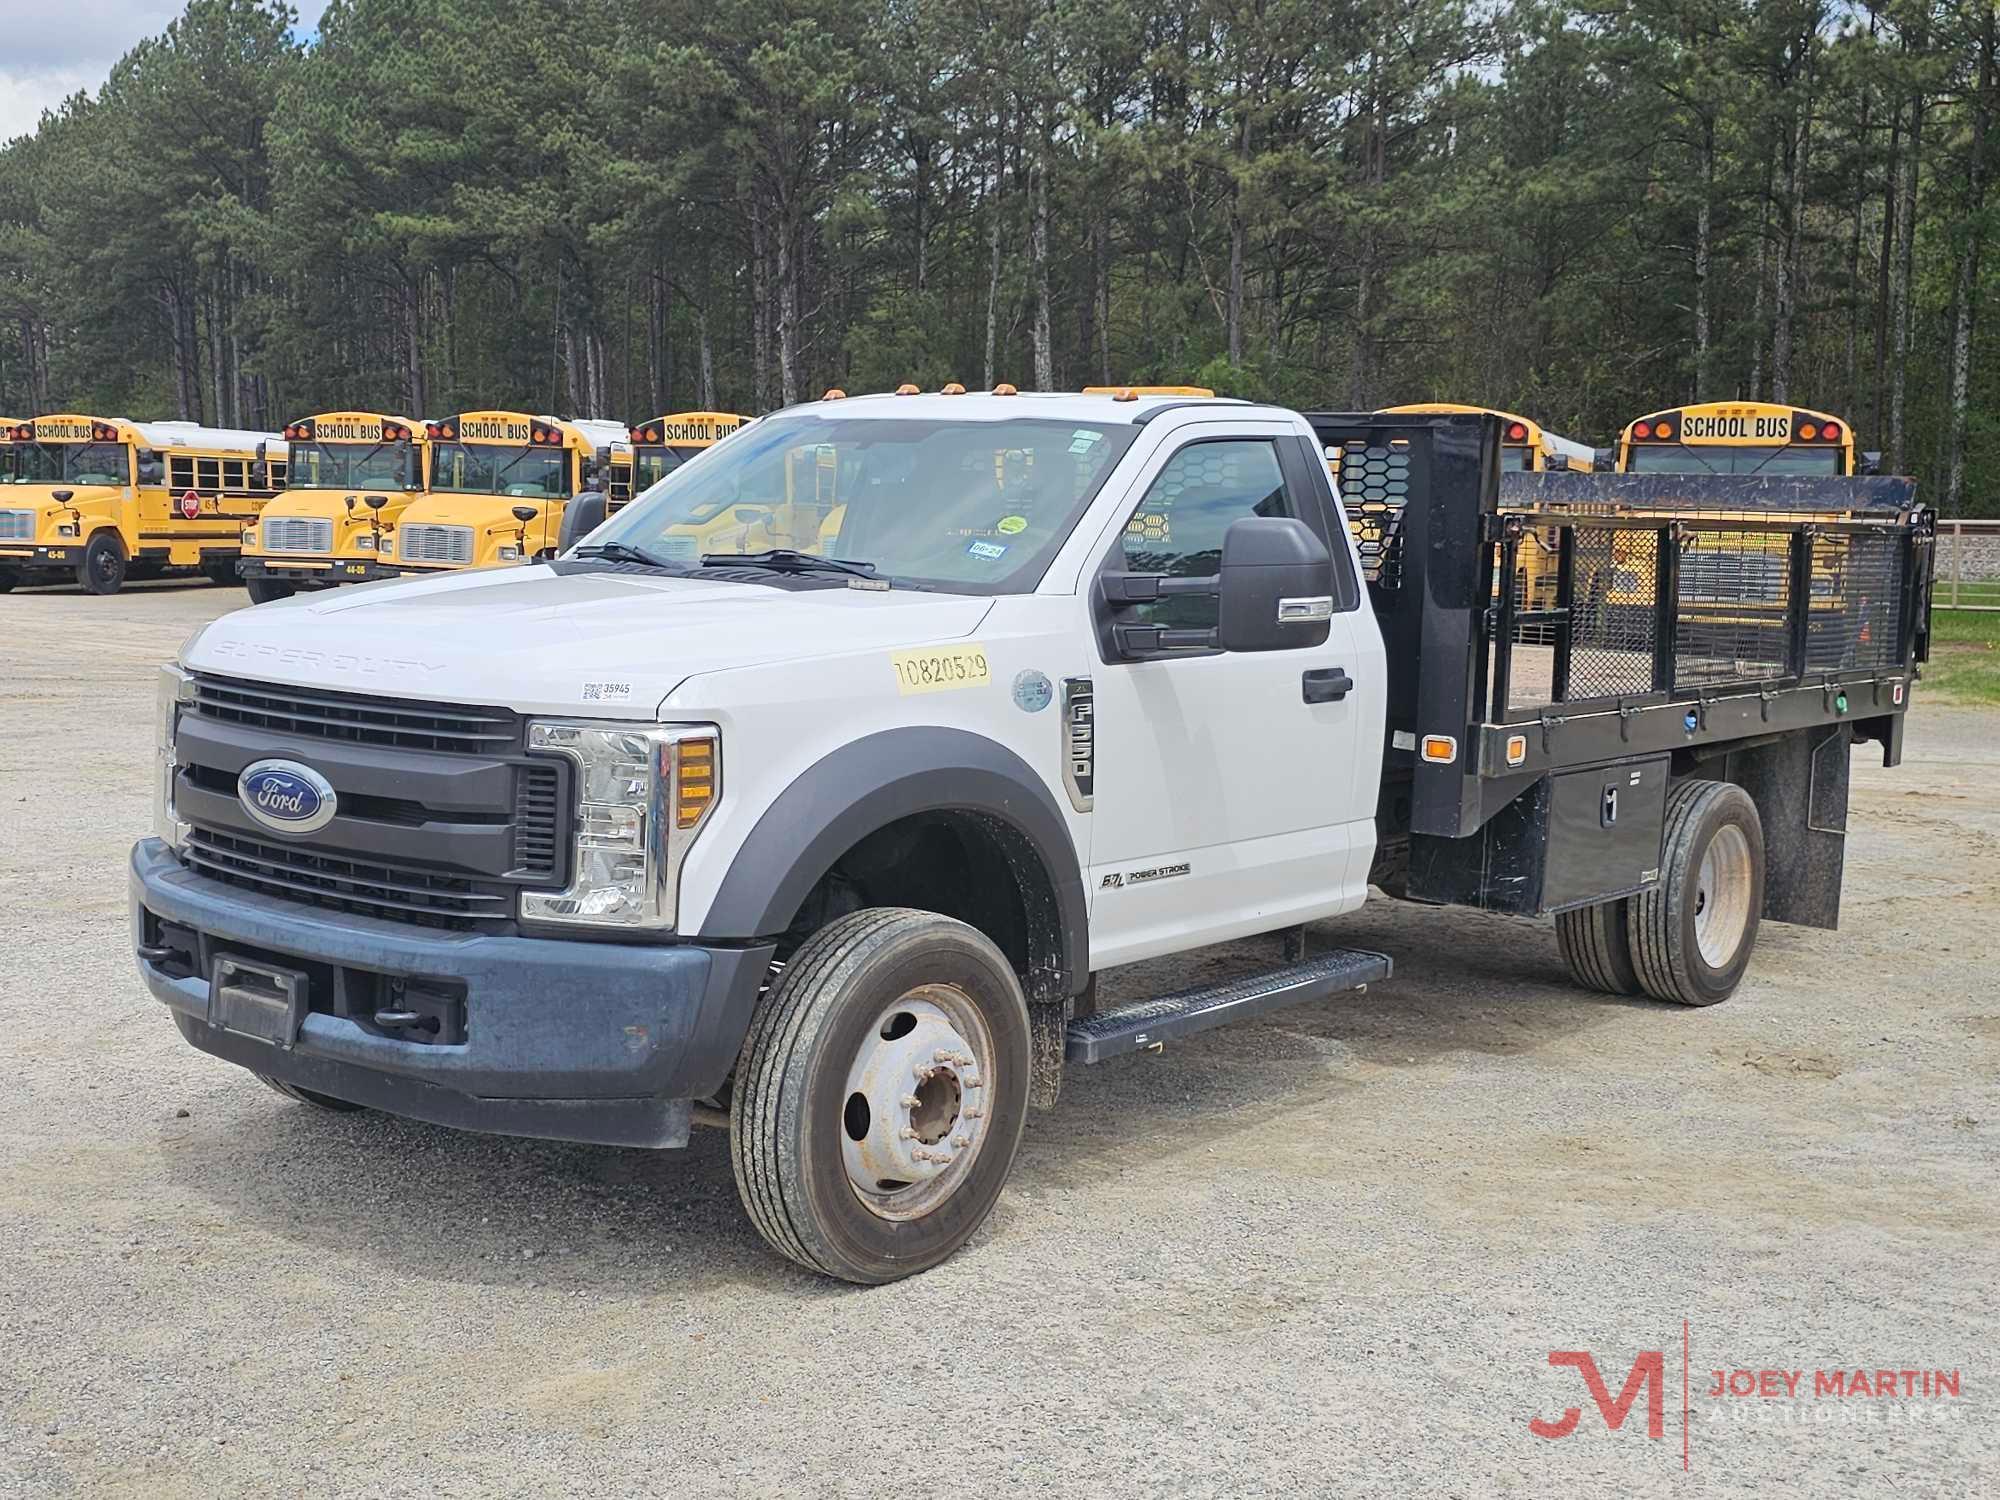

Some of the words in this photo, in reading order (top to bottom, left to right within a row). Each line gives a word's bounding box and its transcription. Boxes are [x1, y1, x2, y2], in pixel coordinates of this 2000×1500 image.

[37, 424, 71, 438] SCHOOL
[74, 425, 91, 439] BUS
[316, 423, 356, 439] SCHOOL
[360, 424, 380, 440] BUS
[461, 422, 502, 439] SCHOOL
[508, 424, 528, 440] BUS
[667, 424, 711, 440] SCHOOL
[1683, 417, 1747, 437] SCHOOL
[1756, 418, 1788, 438] BUS
[184, 499, 198, 510] STOP
[211, 640, 325, 665] SUPER
[331, 653, 447, 678] DUTY
[603, 683, 631, 694] 35945
[257, 777, 304, 813] Ford
[1129, 869, 1157, 881] POWER
[1159, 863, 1191, 876] STROKE
